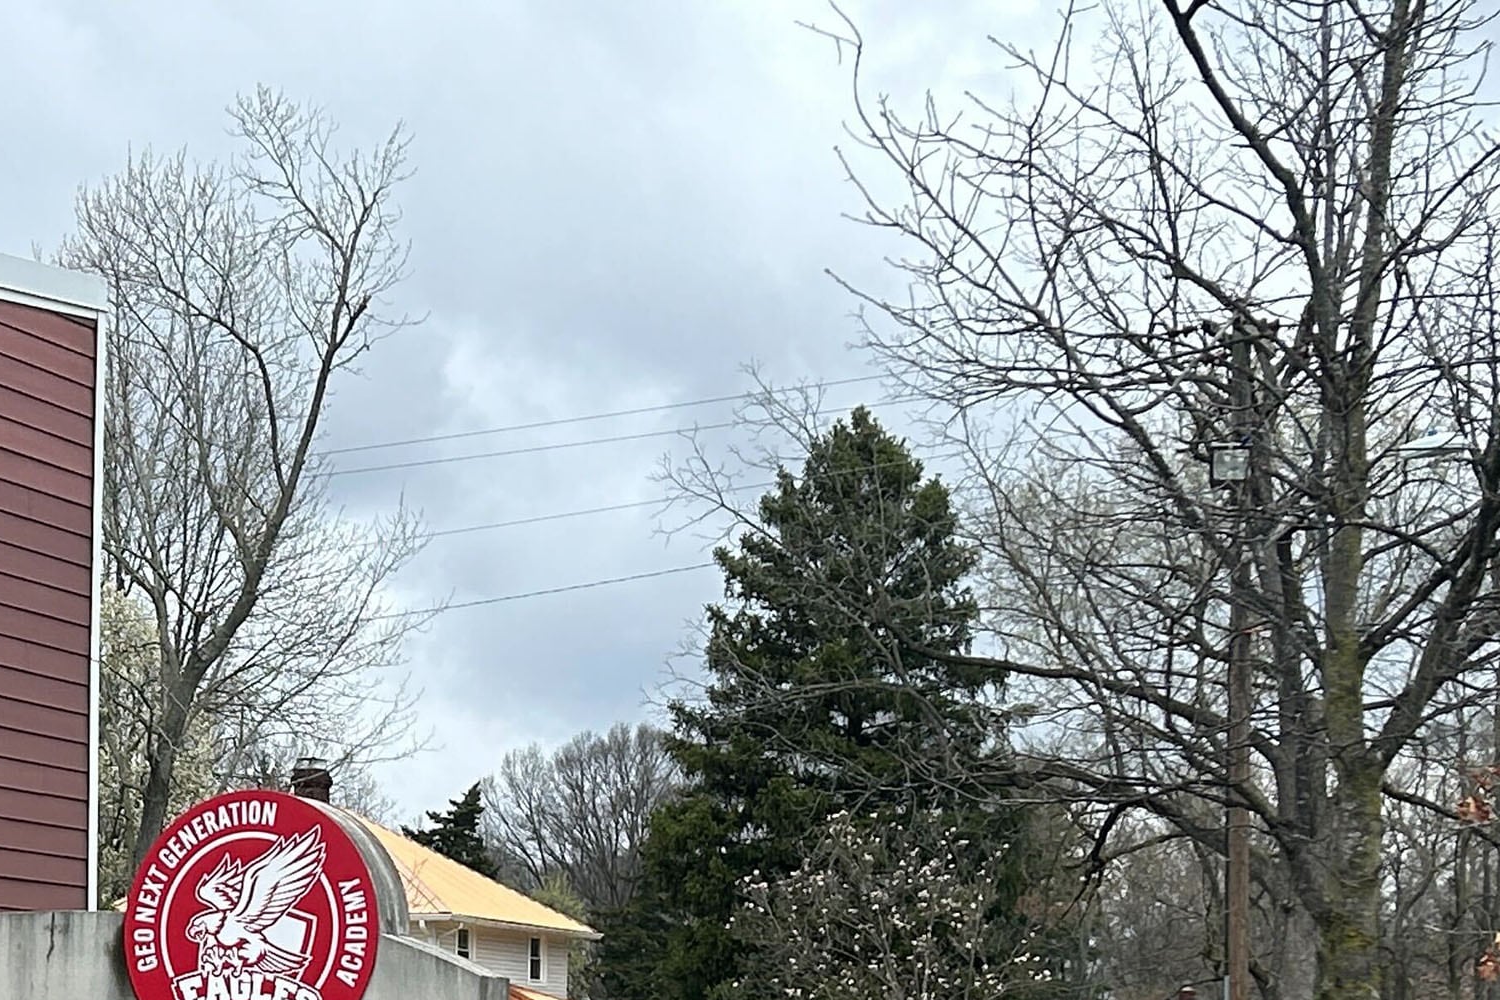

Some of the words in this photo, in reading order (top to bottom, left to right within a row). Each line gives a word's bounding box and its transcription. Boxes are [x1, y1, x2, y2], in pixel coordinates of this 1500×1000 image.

[159, 800, 278, 869] GENERATION
[135, 864, 169, 925] NEXT
[133, 929, 159, 972] GEO
[336, 878, 368, 988] ACADEMY
